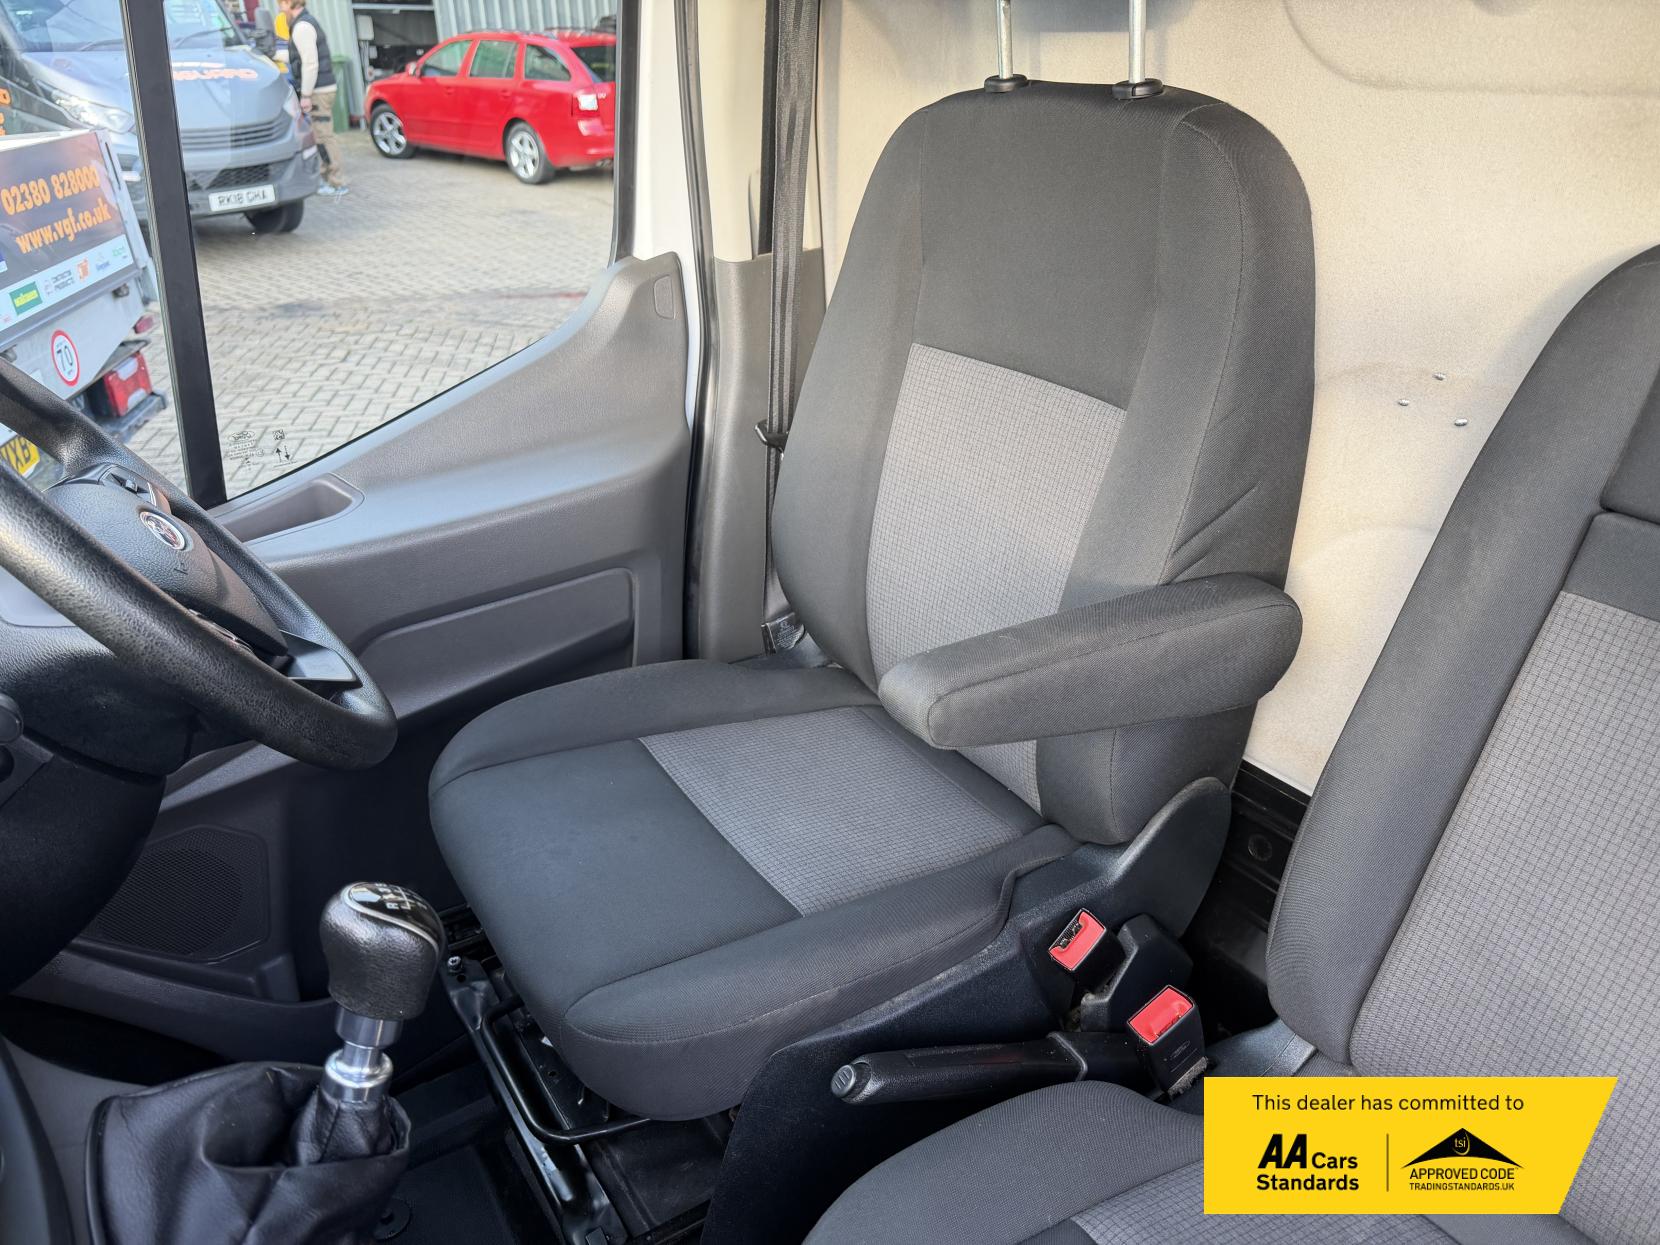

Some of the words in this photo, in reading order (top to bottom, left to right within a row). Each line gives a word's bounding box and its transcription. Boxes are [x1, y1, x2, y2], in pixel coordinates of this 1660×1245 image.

[1, 178, 51, 216] 02380
[51, 165, 101, 200] 828000
[15, 197, 112, 254] www.vgf.co.uk
[56, 345, 74, 371] 70
